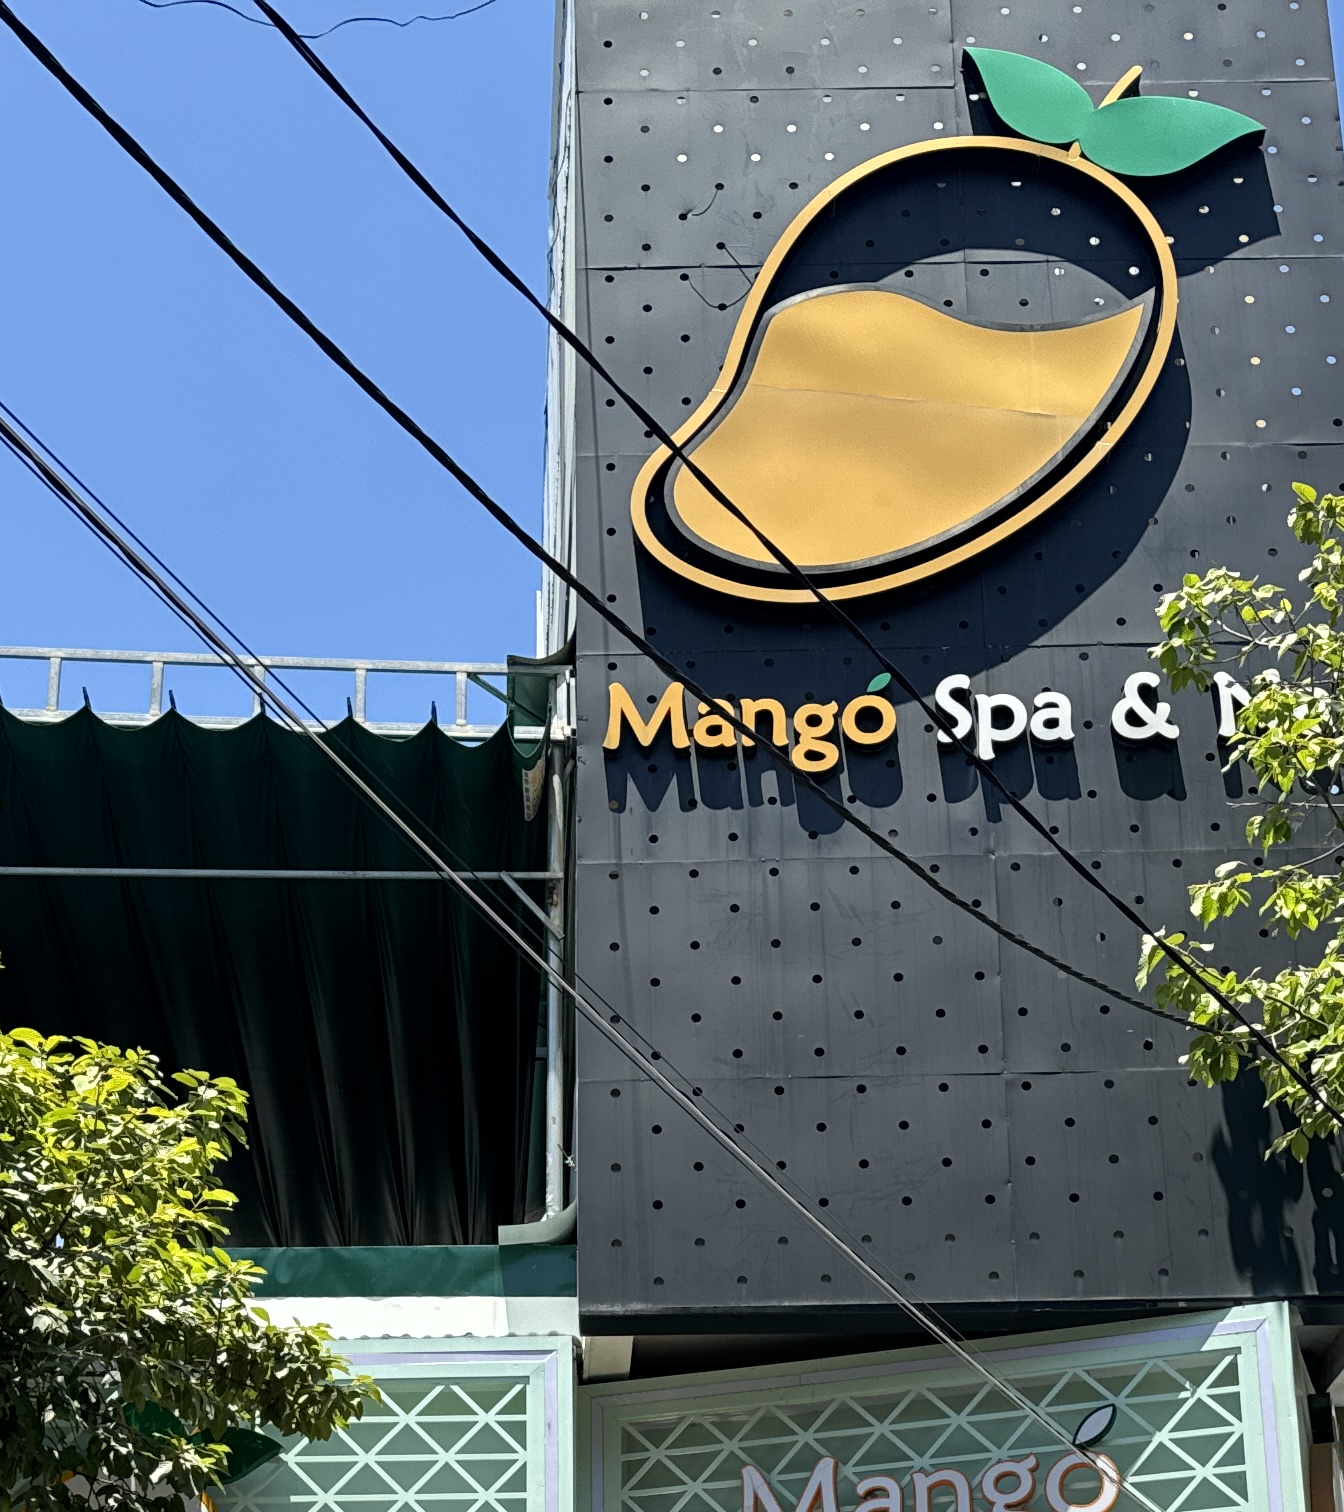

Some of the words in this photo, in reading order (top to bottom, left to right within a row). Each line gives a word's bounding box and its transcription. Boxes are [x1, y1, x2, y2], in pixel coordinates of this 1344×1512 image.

[602, 681, 897, 772] Mango
[935, 674, 1075, 760] Spa
[1112, 671, 1180, 740] &
